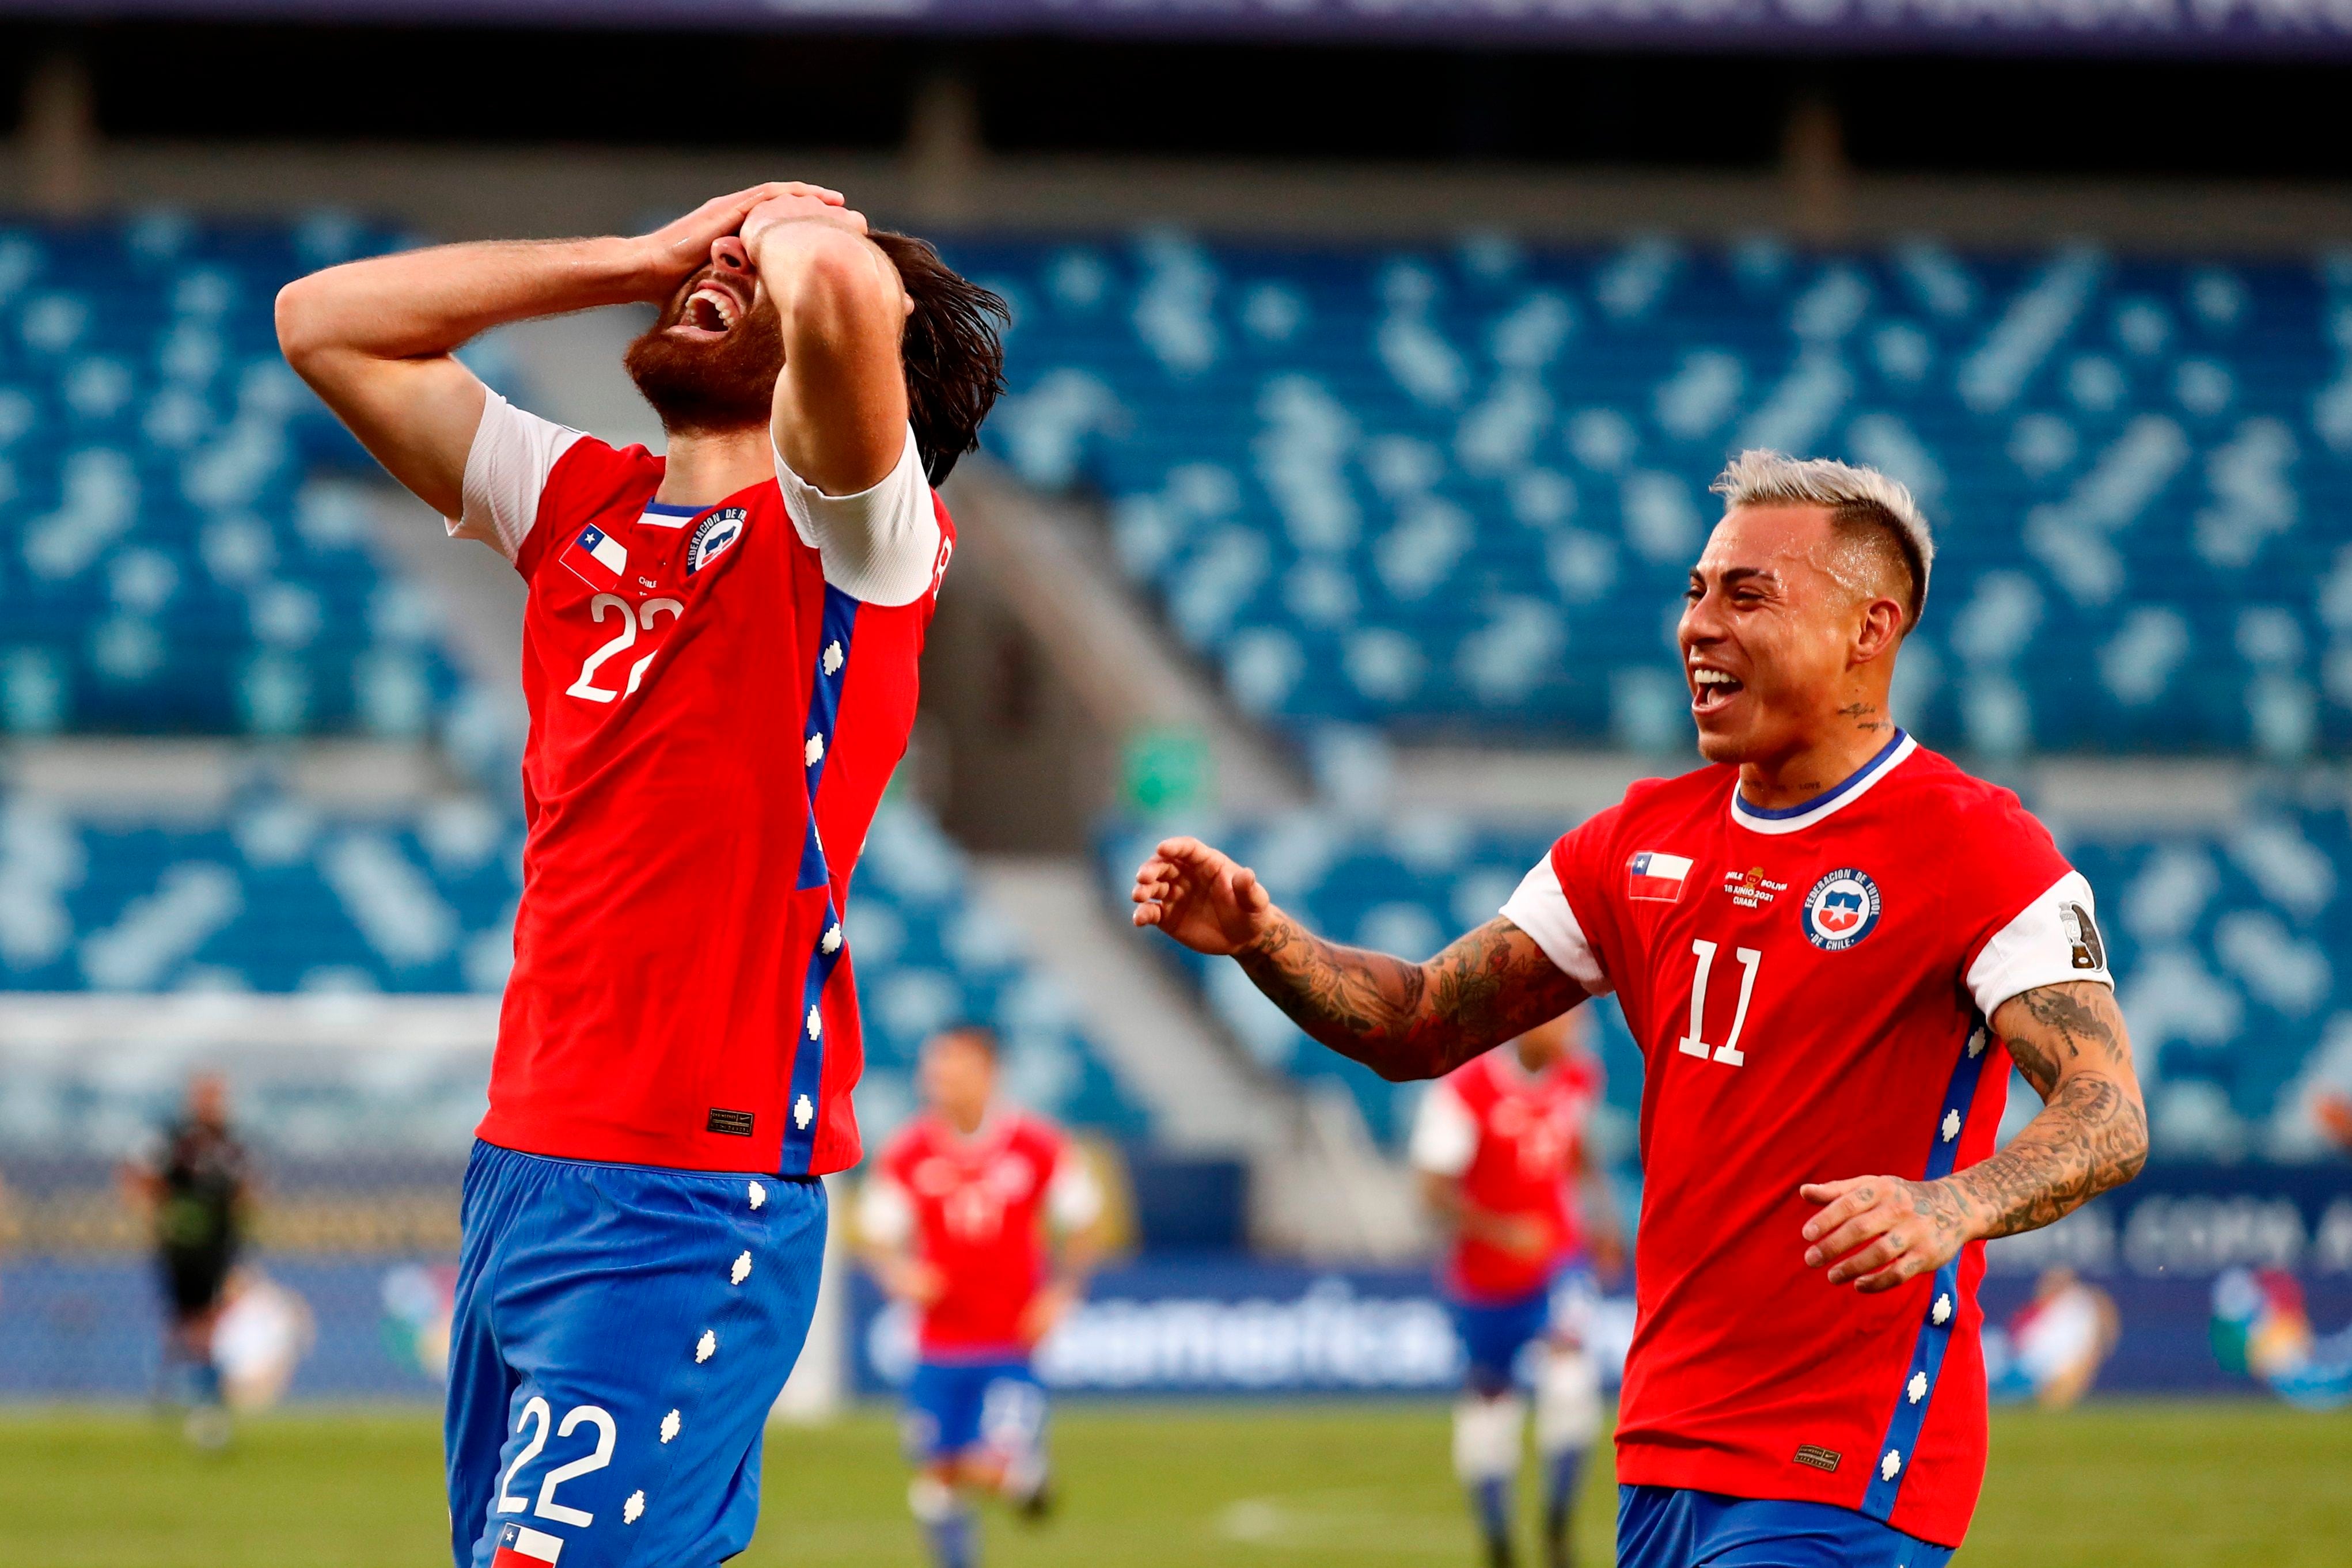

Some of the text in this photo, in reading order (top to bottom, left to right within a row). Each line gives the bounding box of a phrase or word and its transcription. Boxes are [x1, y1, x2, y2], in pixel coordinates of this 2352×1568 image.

[688, 508, 737, 566] FEDERACION DE
[639, 576, 657, 588] CHILE
[1724, 884, 1774, 902] 18 JUNIO 2021
[1804, 869, 1880, 917] FEDERACION DE FUTBOL
[1811, 933, 1851, 951] DE CHILE
[1678, 939, 1762, 1067] 11
[496, 1396, 616, 1528] 22
